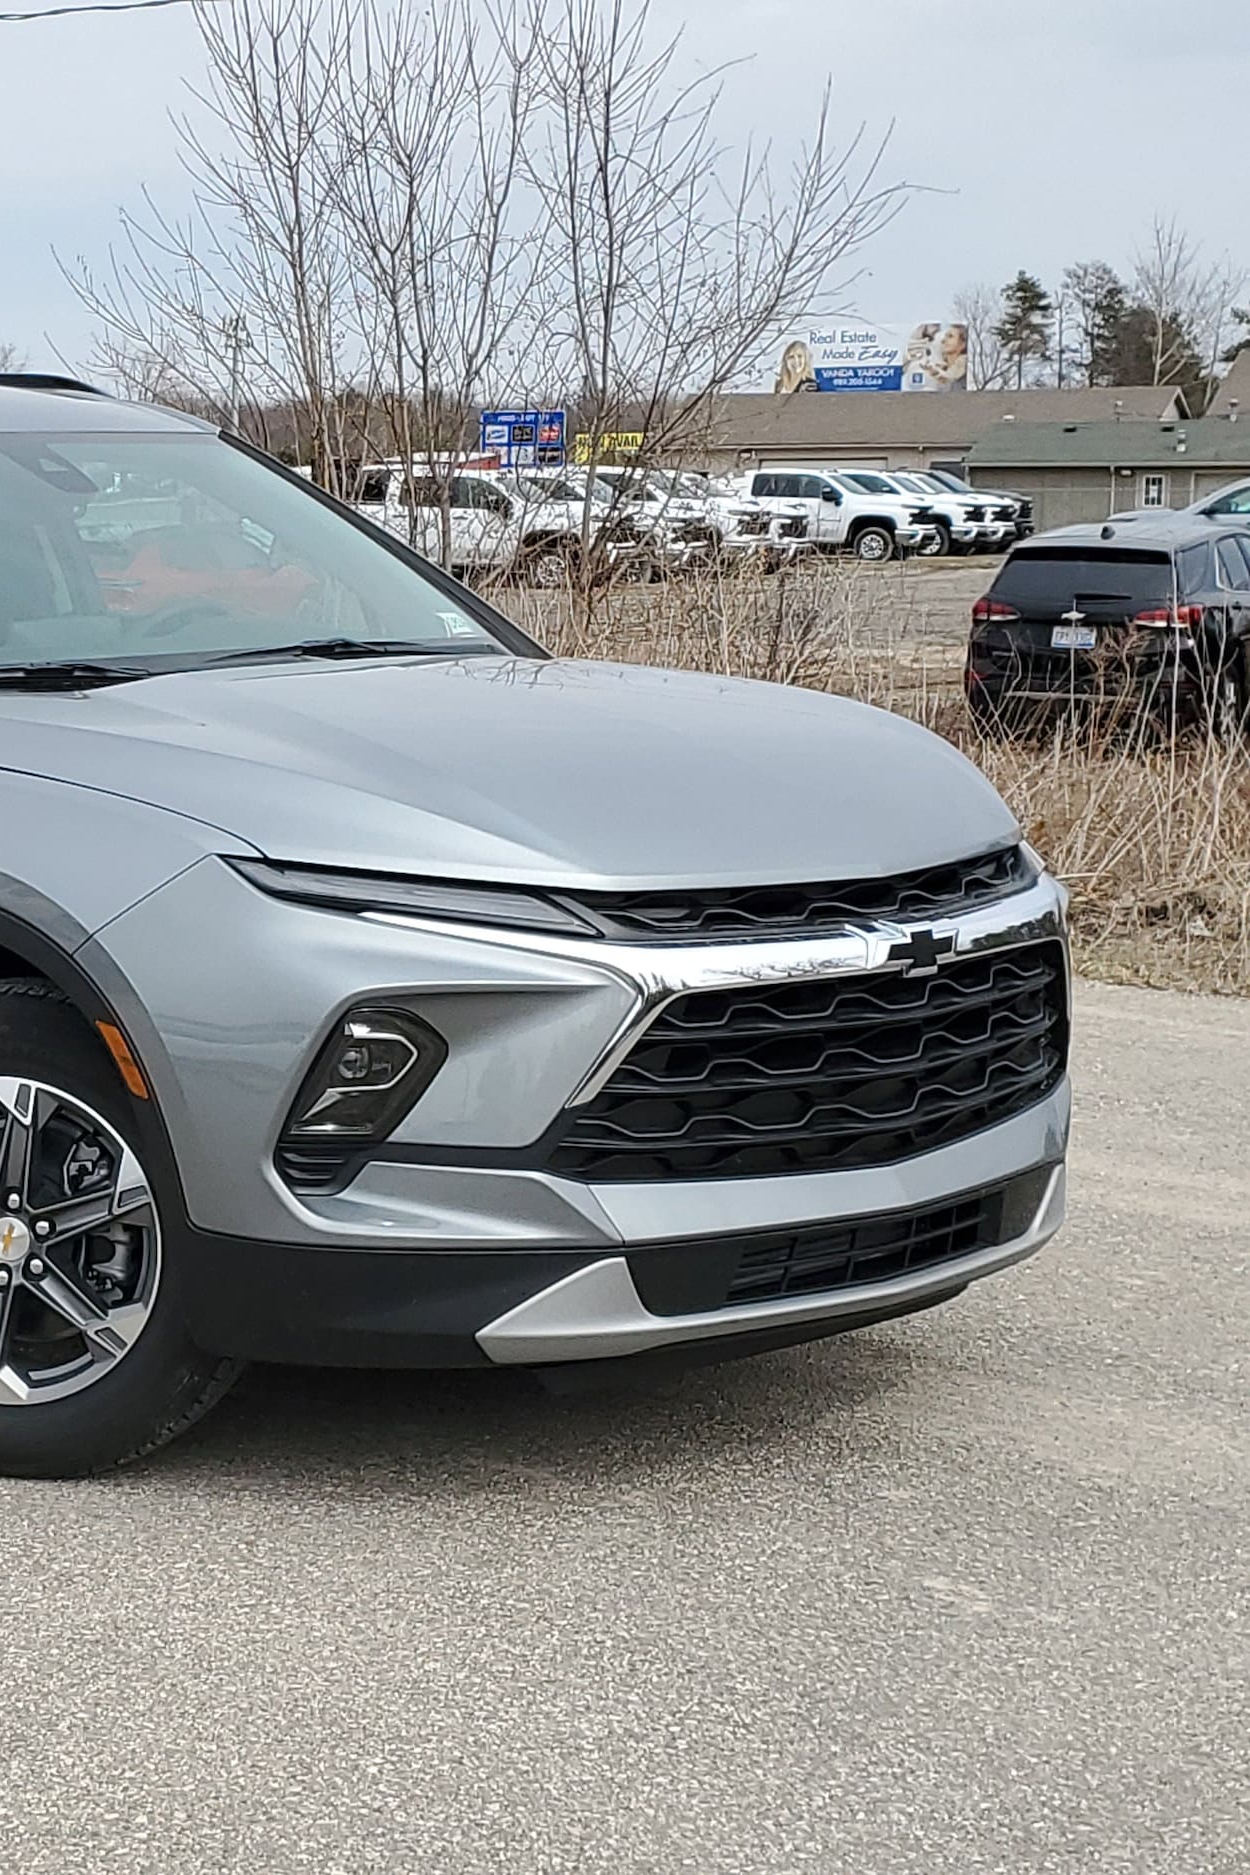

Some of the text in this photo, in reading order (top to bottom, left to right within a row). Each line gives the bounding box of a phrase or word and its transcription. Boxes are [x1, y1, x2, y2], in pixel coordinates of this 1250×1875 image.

[810, 330, 877, 344] Real Estate
[822, 345, 898, 364] Made Easy
